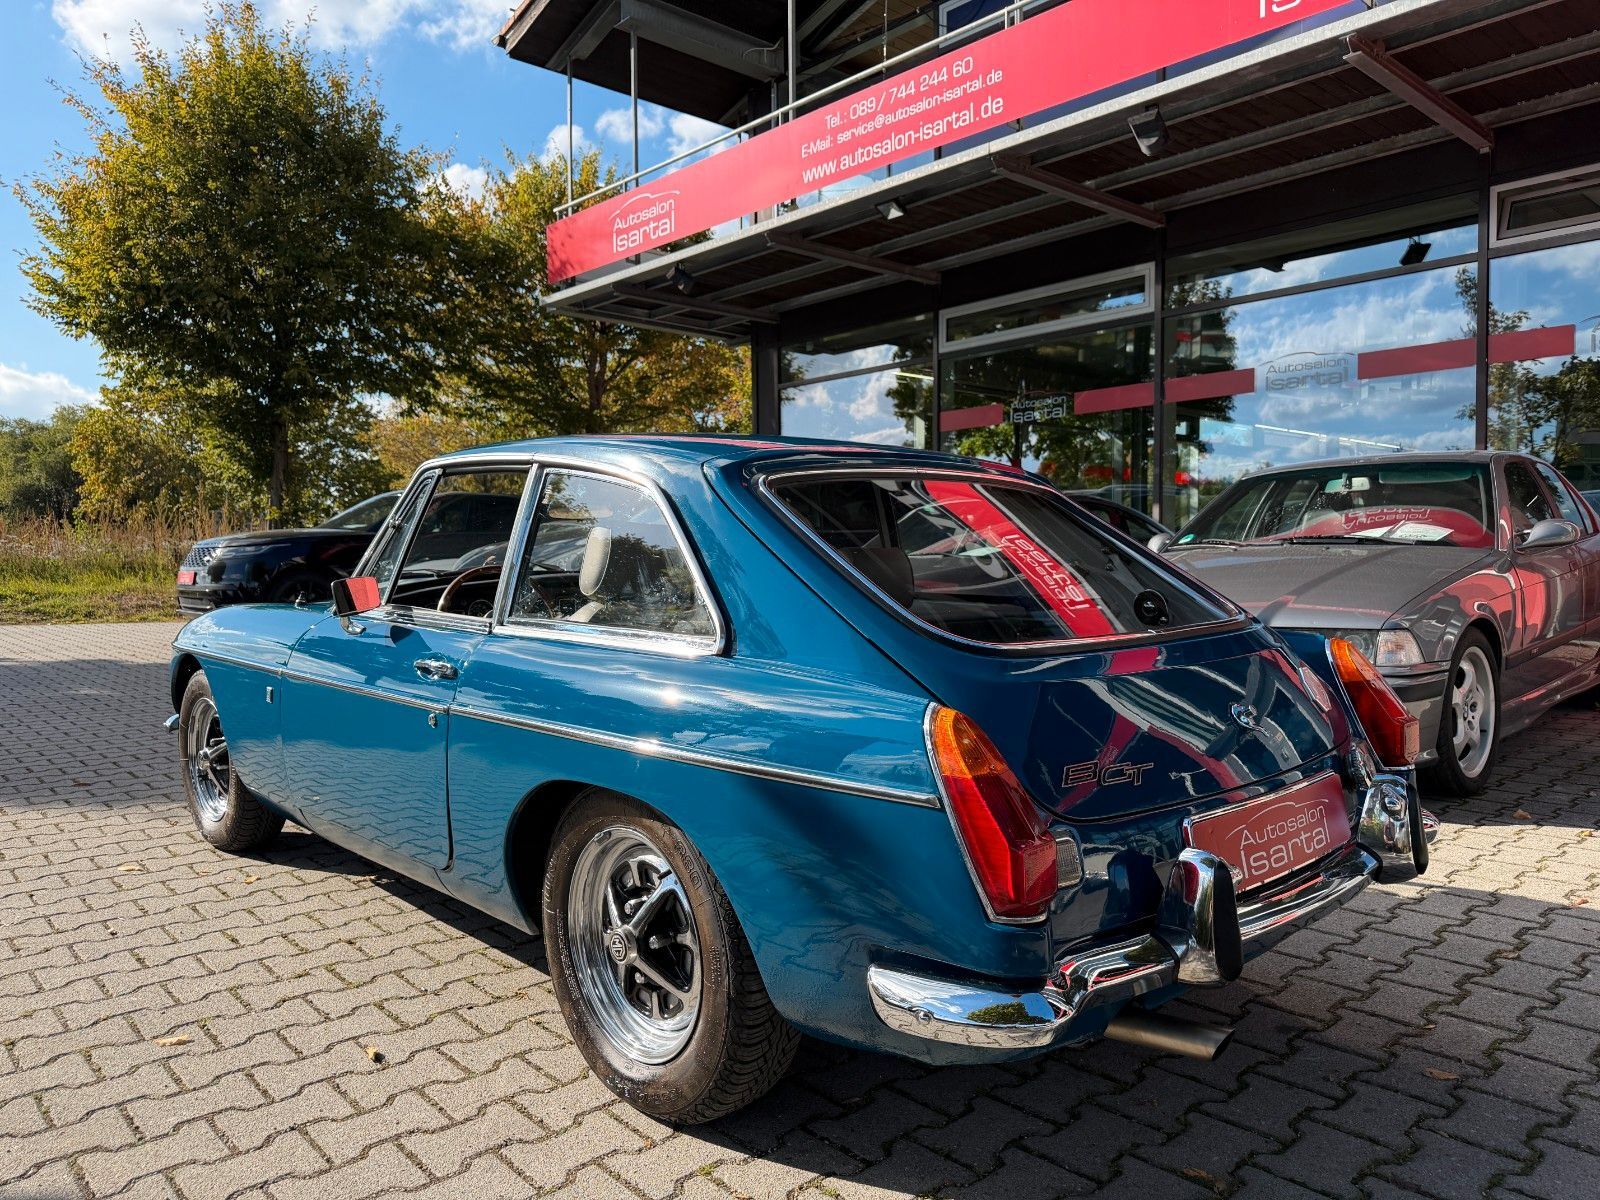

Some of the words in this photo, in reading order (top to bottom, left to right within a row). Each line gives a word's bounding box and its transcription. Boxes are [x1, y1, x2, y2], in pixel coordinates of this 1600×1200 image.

[801, 135, 834, 158] E-Mail:
[836, 68, 1003, 144] service@autosalon-isartal.de
[824, 111, 847, 130] Tel.:
[849, 96, 876, 120] 089
[889, 79, 915, 104] 744
[920, 67, 948, 92] 244
[952, 56, 973, 78] 60
[802, 97, 1004, 183] www.autosalon-isartal.de
[612, 199, 675, 233] Autosalon
[612, 209, 675, 254] Isartal
[1265, 366, 1349, 392] Isartal
[1266, 357, 1349, 375] Autosalon
[1010, 395, 1067, 409] Autosalon
[1010, 403, 1067, 423] Isartal
[1240, 806, 1327, 850] Autosalon
[1240, 817, 1331, 879] Isartal
